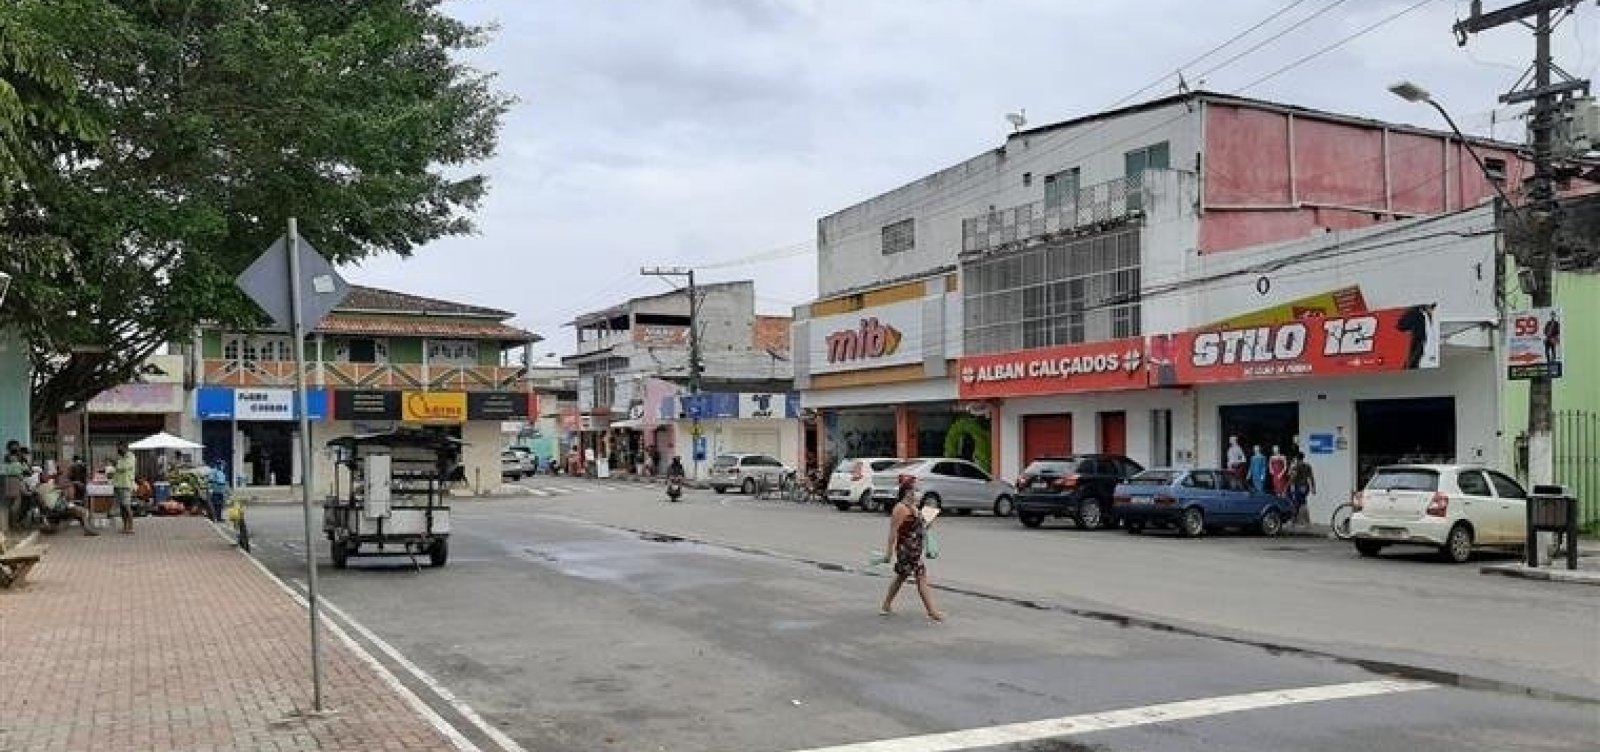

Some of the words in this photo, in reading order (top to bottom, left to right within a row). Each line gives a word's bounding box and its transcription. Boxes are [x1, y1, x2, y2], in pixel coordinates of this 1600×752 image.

[825, 316, 886, 363] mib
[1192, 322, 1307, 367] STILO
[1323, 315, 1379, 356] 12
[1515, 316, 1538, 336] 59
[977, 361, 1025, 382] ALBAN
[1029, 352, 1119, 380] CALÇADOS
